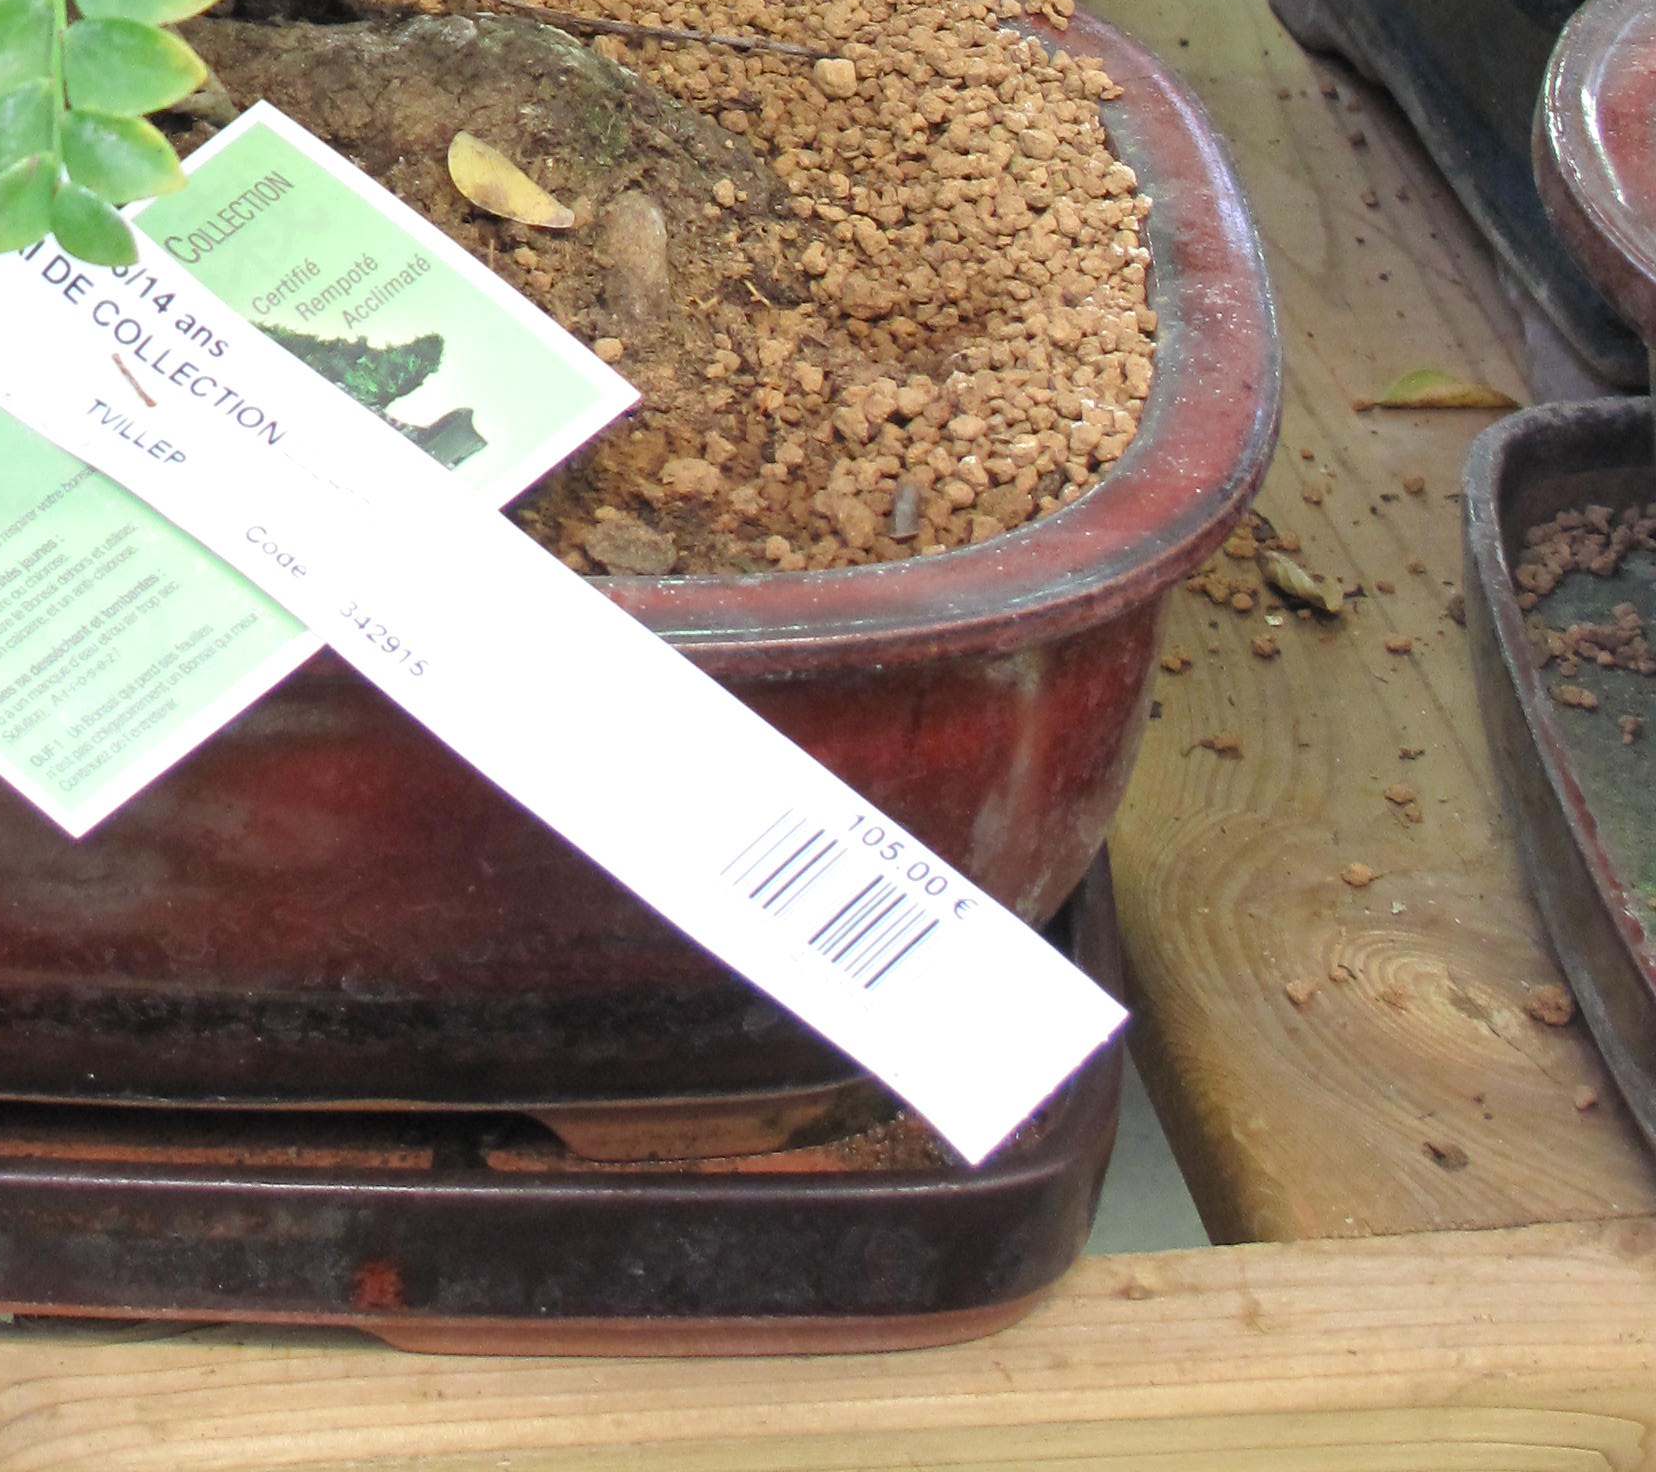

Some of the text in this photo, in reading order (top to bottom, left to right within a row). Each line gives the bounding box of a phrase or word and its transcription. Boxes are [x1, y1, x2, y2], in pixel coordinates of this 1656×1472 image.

[251, 256, 323, 320] Certifié
[295, 251, 379, 325] Rempoté
[342, 254, 433, 331] Acclimaté
[42, 254, 287, 446] DE COLLECTION
[175, 313, 229, 358] ans
[87, 398, 187, 466] TVILLEP
[244, 522, 432, 679] Code 342915
[849, 816, 948, 896] 105.00
